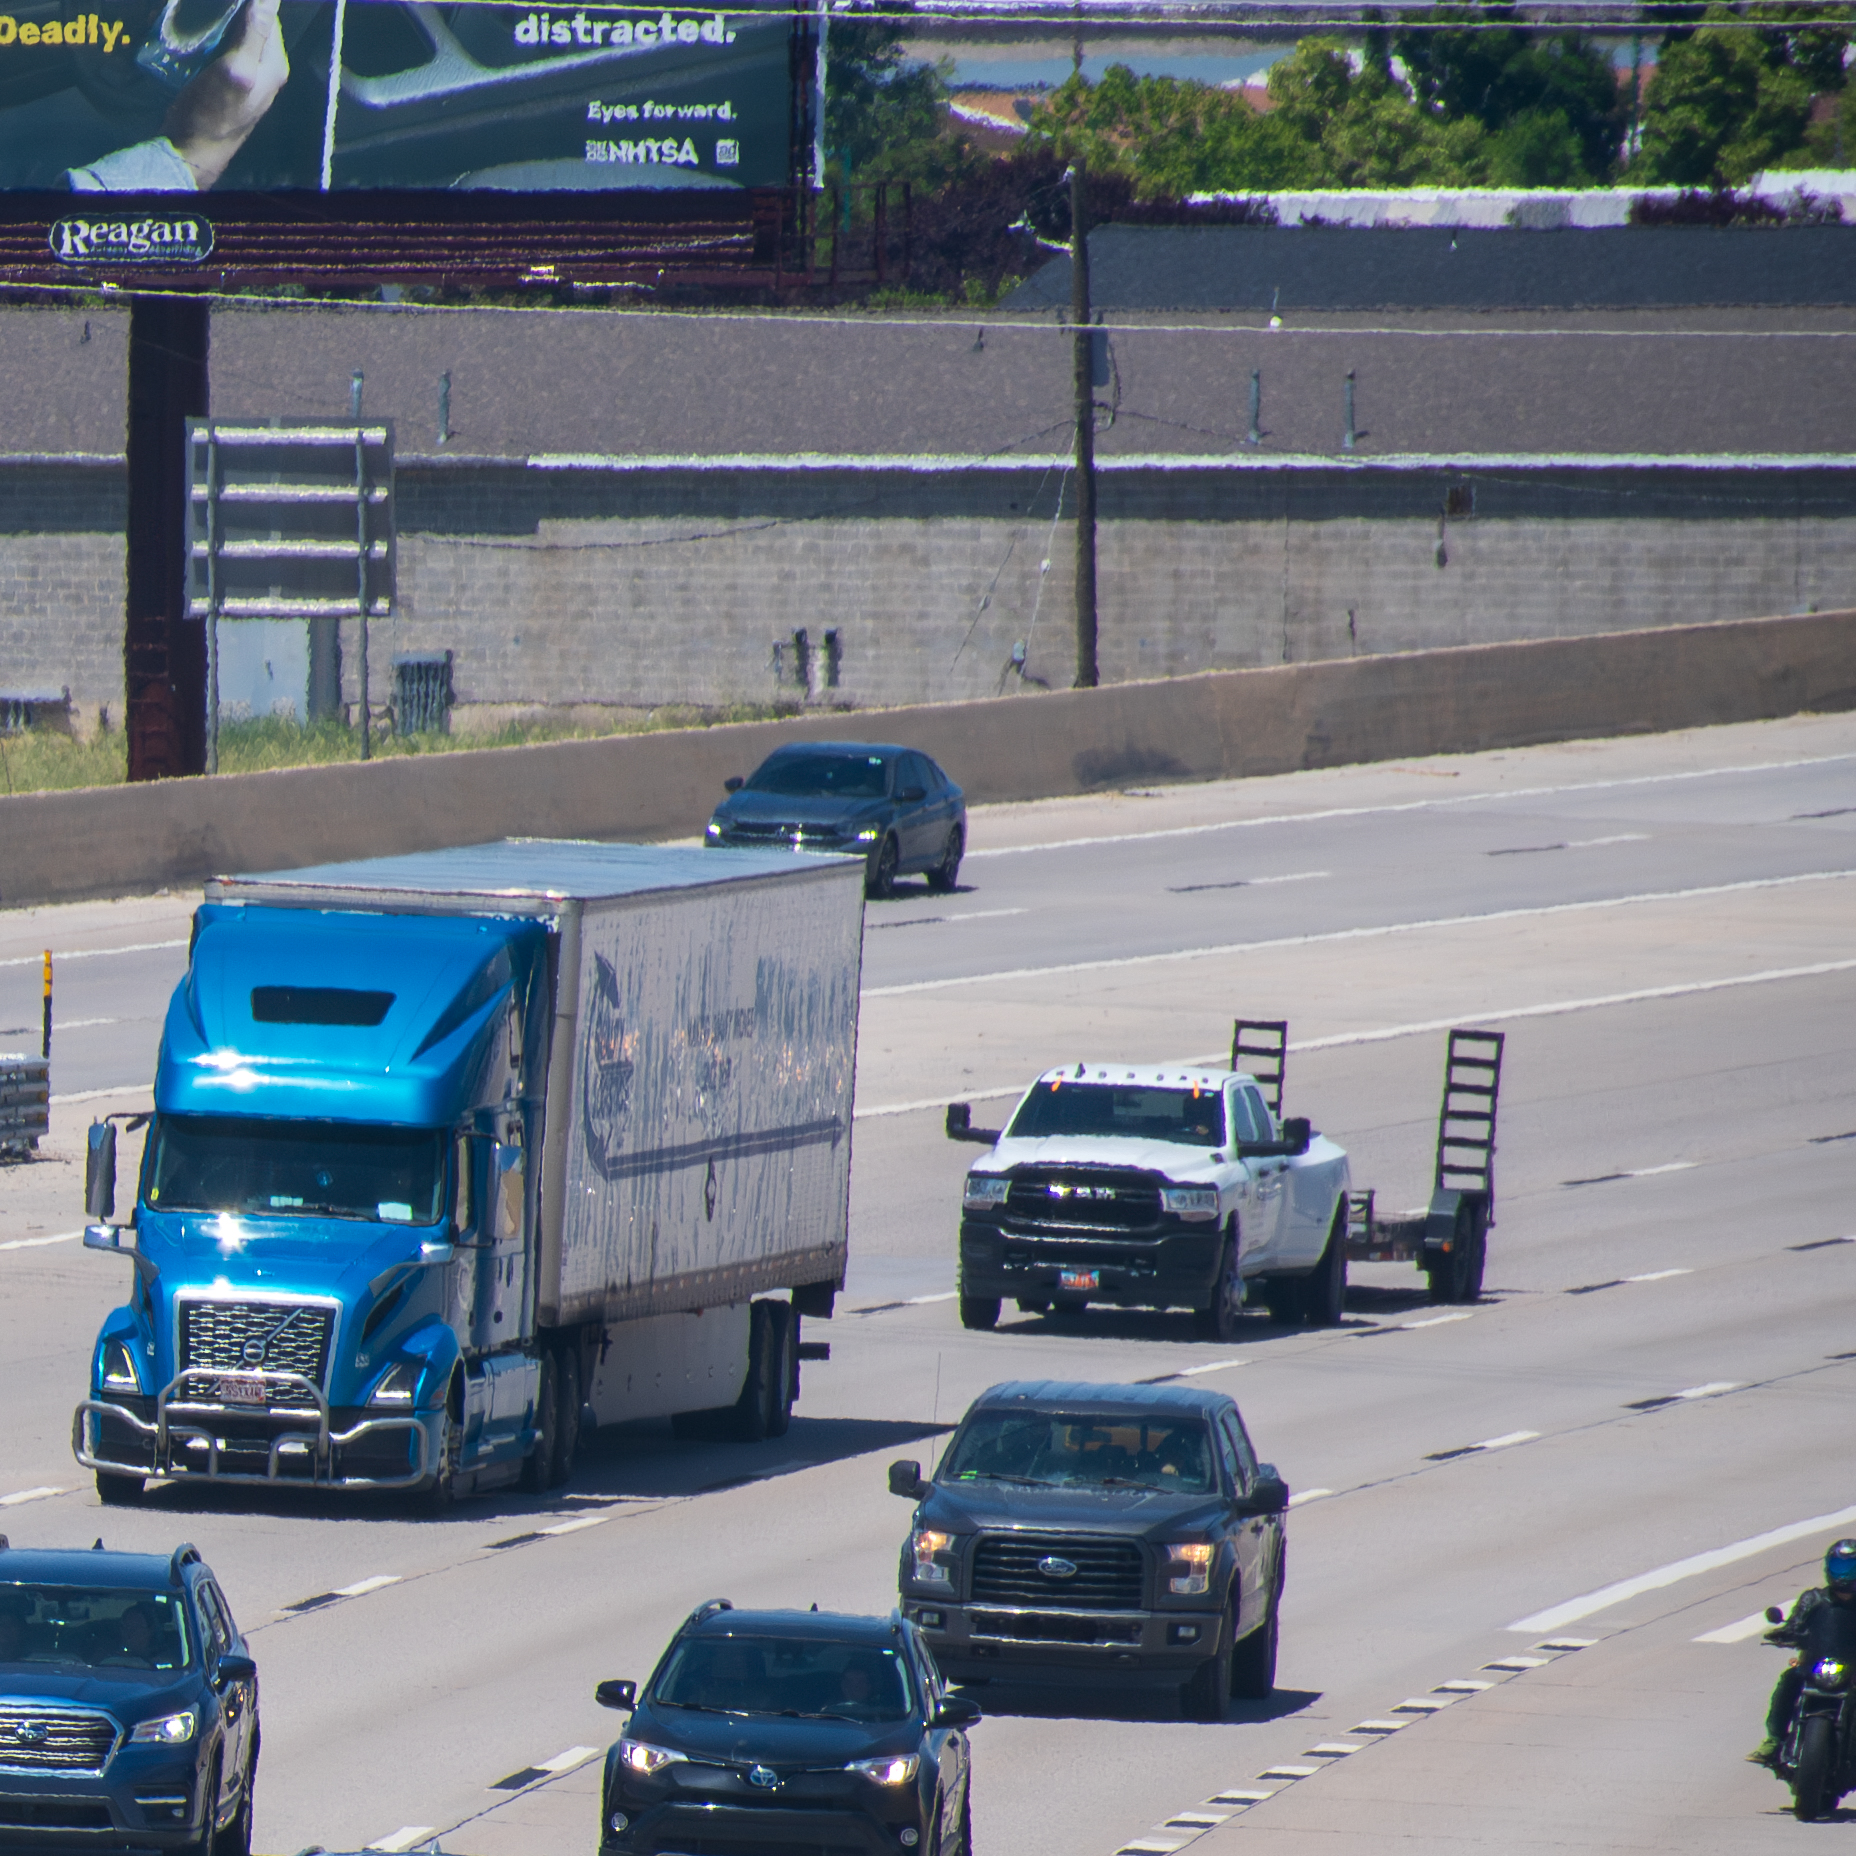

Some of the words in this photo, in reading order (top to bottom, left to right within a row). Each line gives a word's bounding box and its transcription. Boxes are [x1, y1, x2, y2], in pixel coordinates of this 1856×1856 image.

[514, 12, 737, 45] distracted.
[588, 100, 639, 124] Eyes
[643, 100, 738, 121] forward.
[608, 137, 699, 165] NHTSA
[60, 218, 200, 255] Reagan
